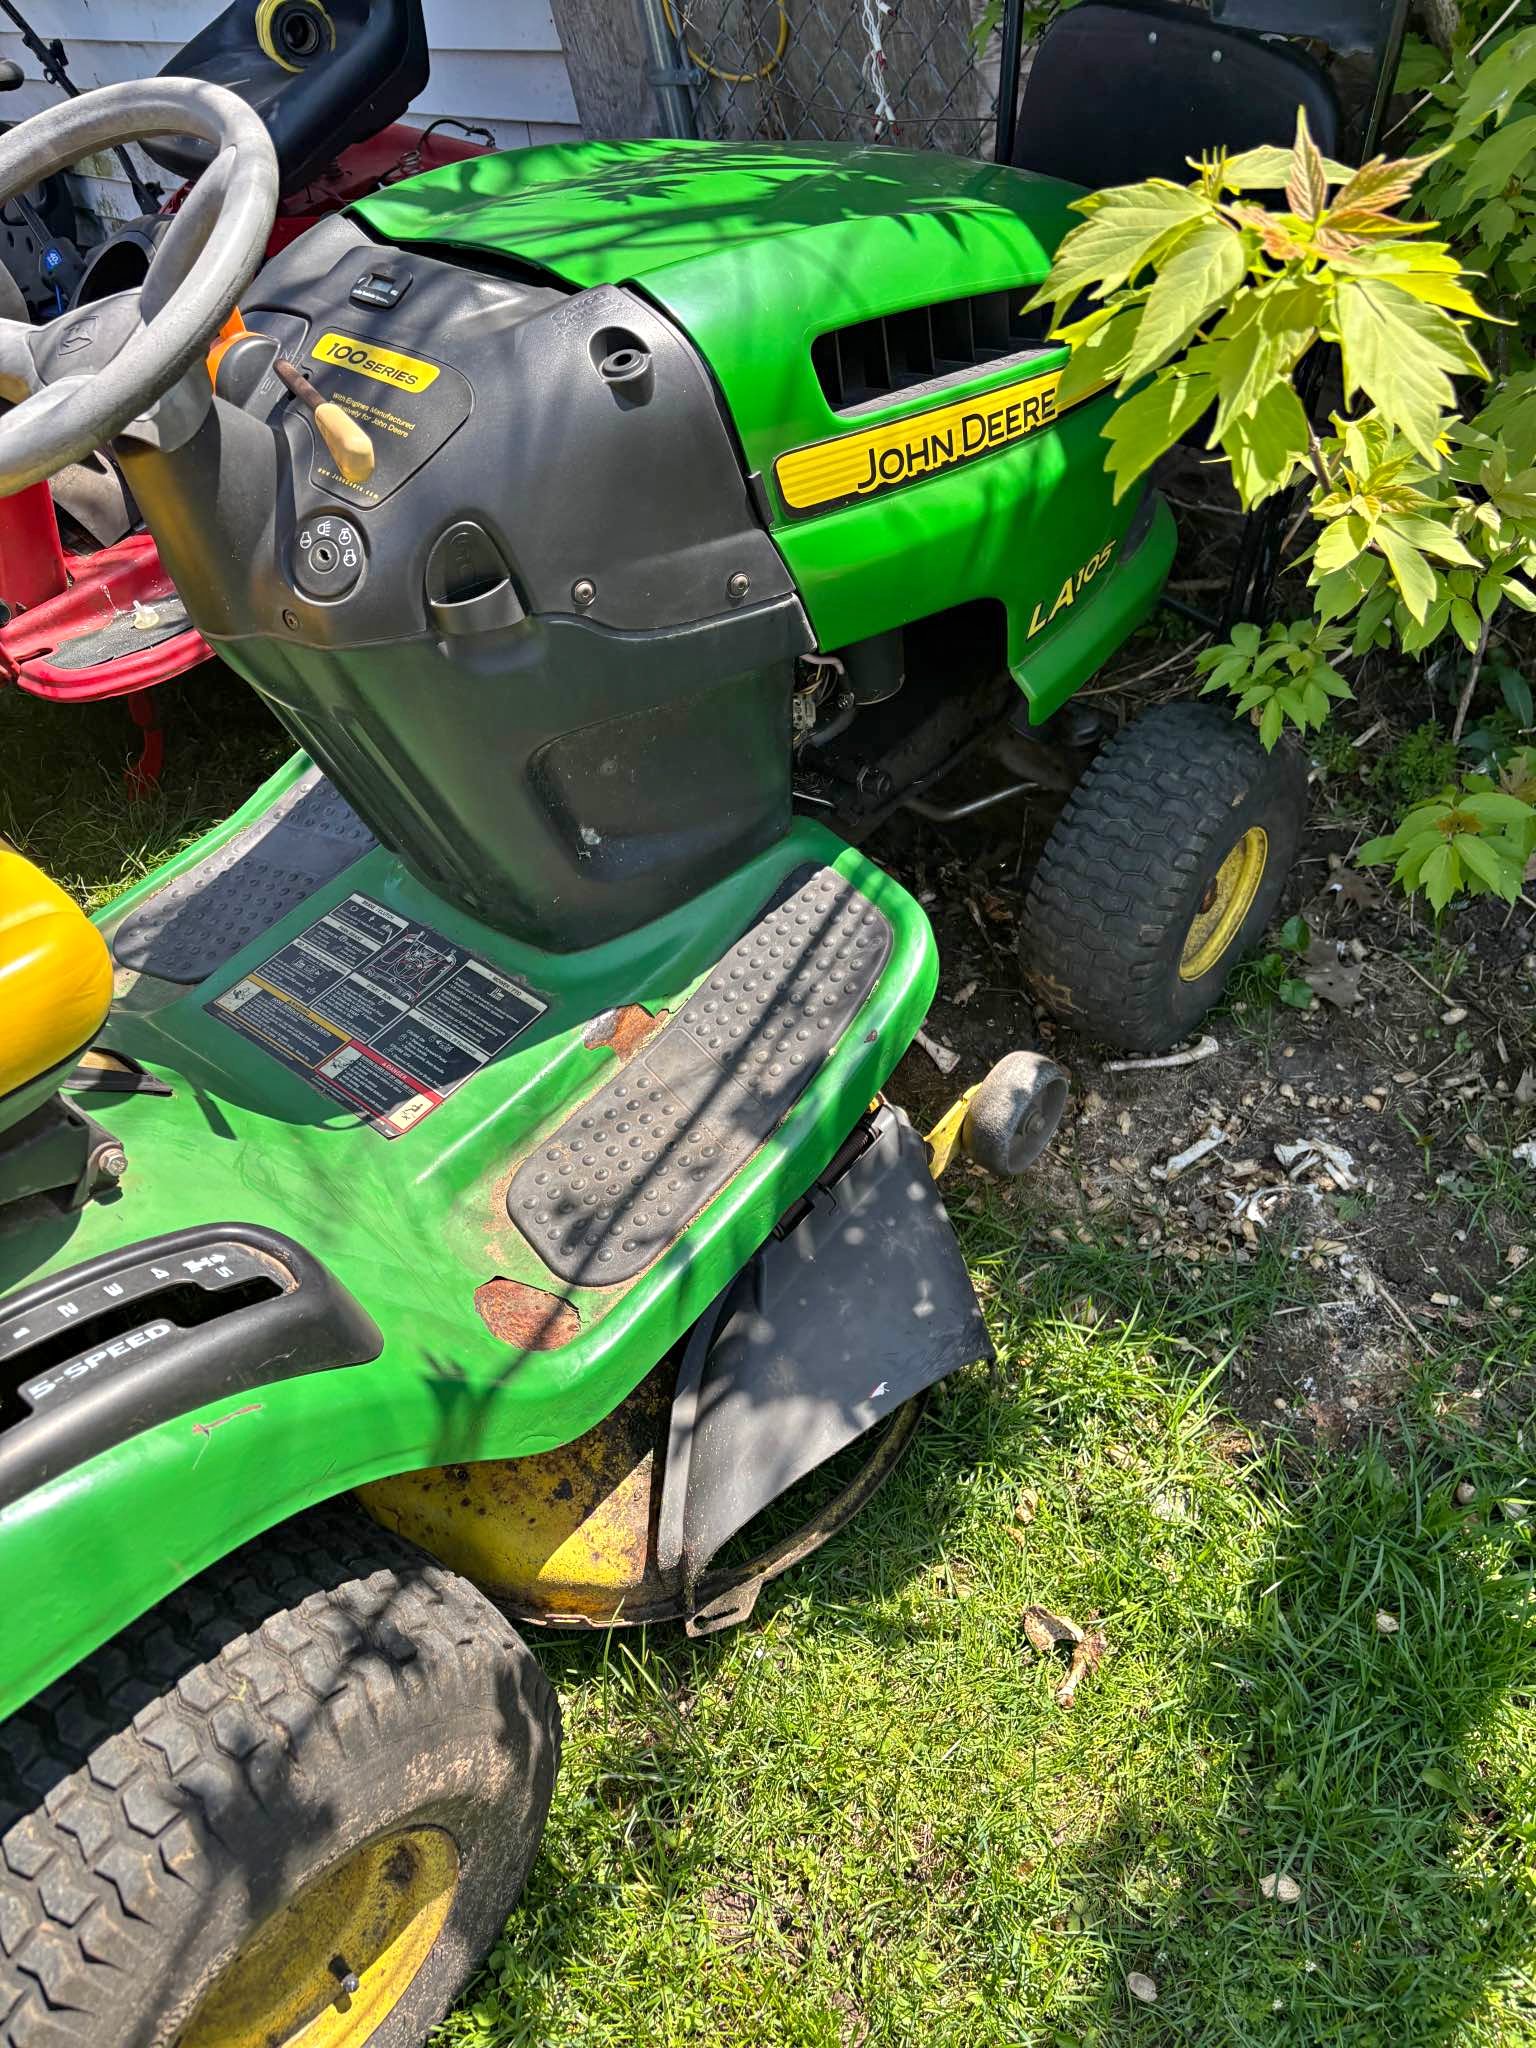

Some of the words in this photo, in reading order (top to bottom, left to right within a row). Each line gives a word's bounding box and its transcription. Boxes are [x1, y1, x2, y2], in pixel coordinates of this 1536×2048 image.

[326, 342, 368, 364] 100
[362, 359, 418, 385] SERIES
[346, 397, 369, 413] Engines
[370, 405, 416, 431] Manufactured
[361, 411, 372, 421] for
[371, 416, 388, 430] John
[387, 424, 409, 439] Deere
[857, 428, 953, 490] JOHN
[961, 388, 1056, 450] DEERE
[1026, 539, 1117, 640] LA105
[385, 1064, 408, 1079] DANGER
[150, 1267, 171, 1280] 4
[216, 1265, 235, 1278] 5
[103, 1282, 124, 1297] 3
[57, 1302, 79, 1318] 2
[27, 1324, 172, 1400] 5-SPEED
